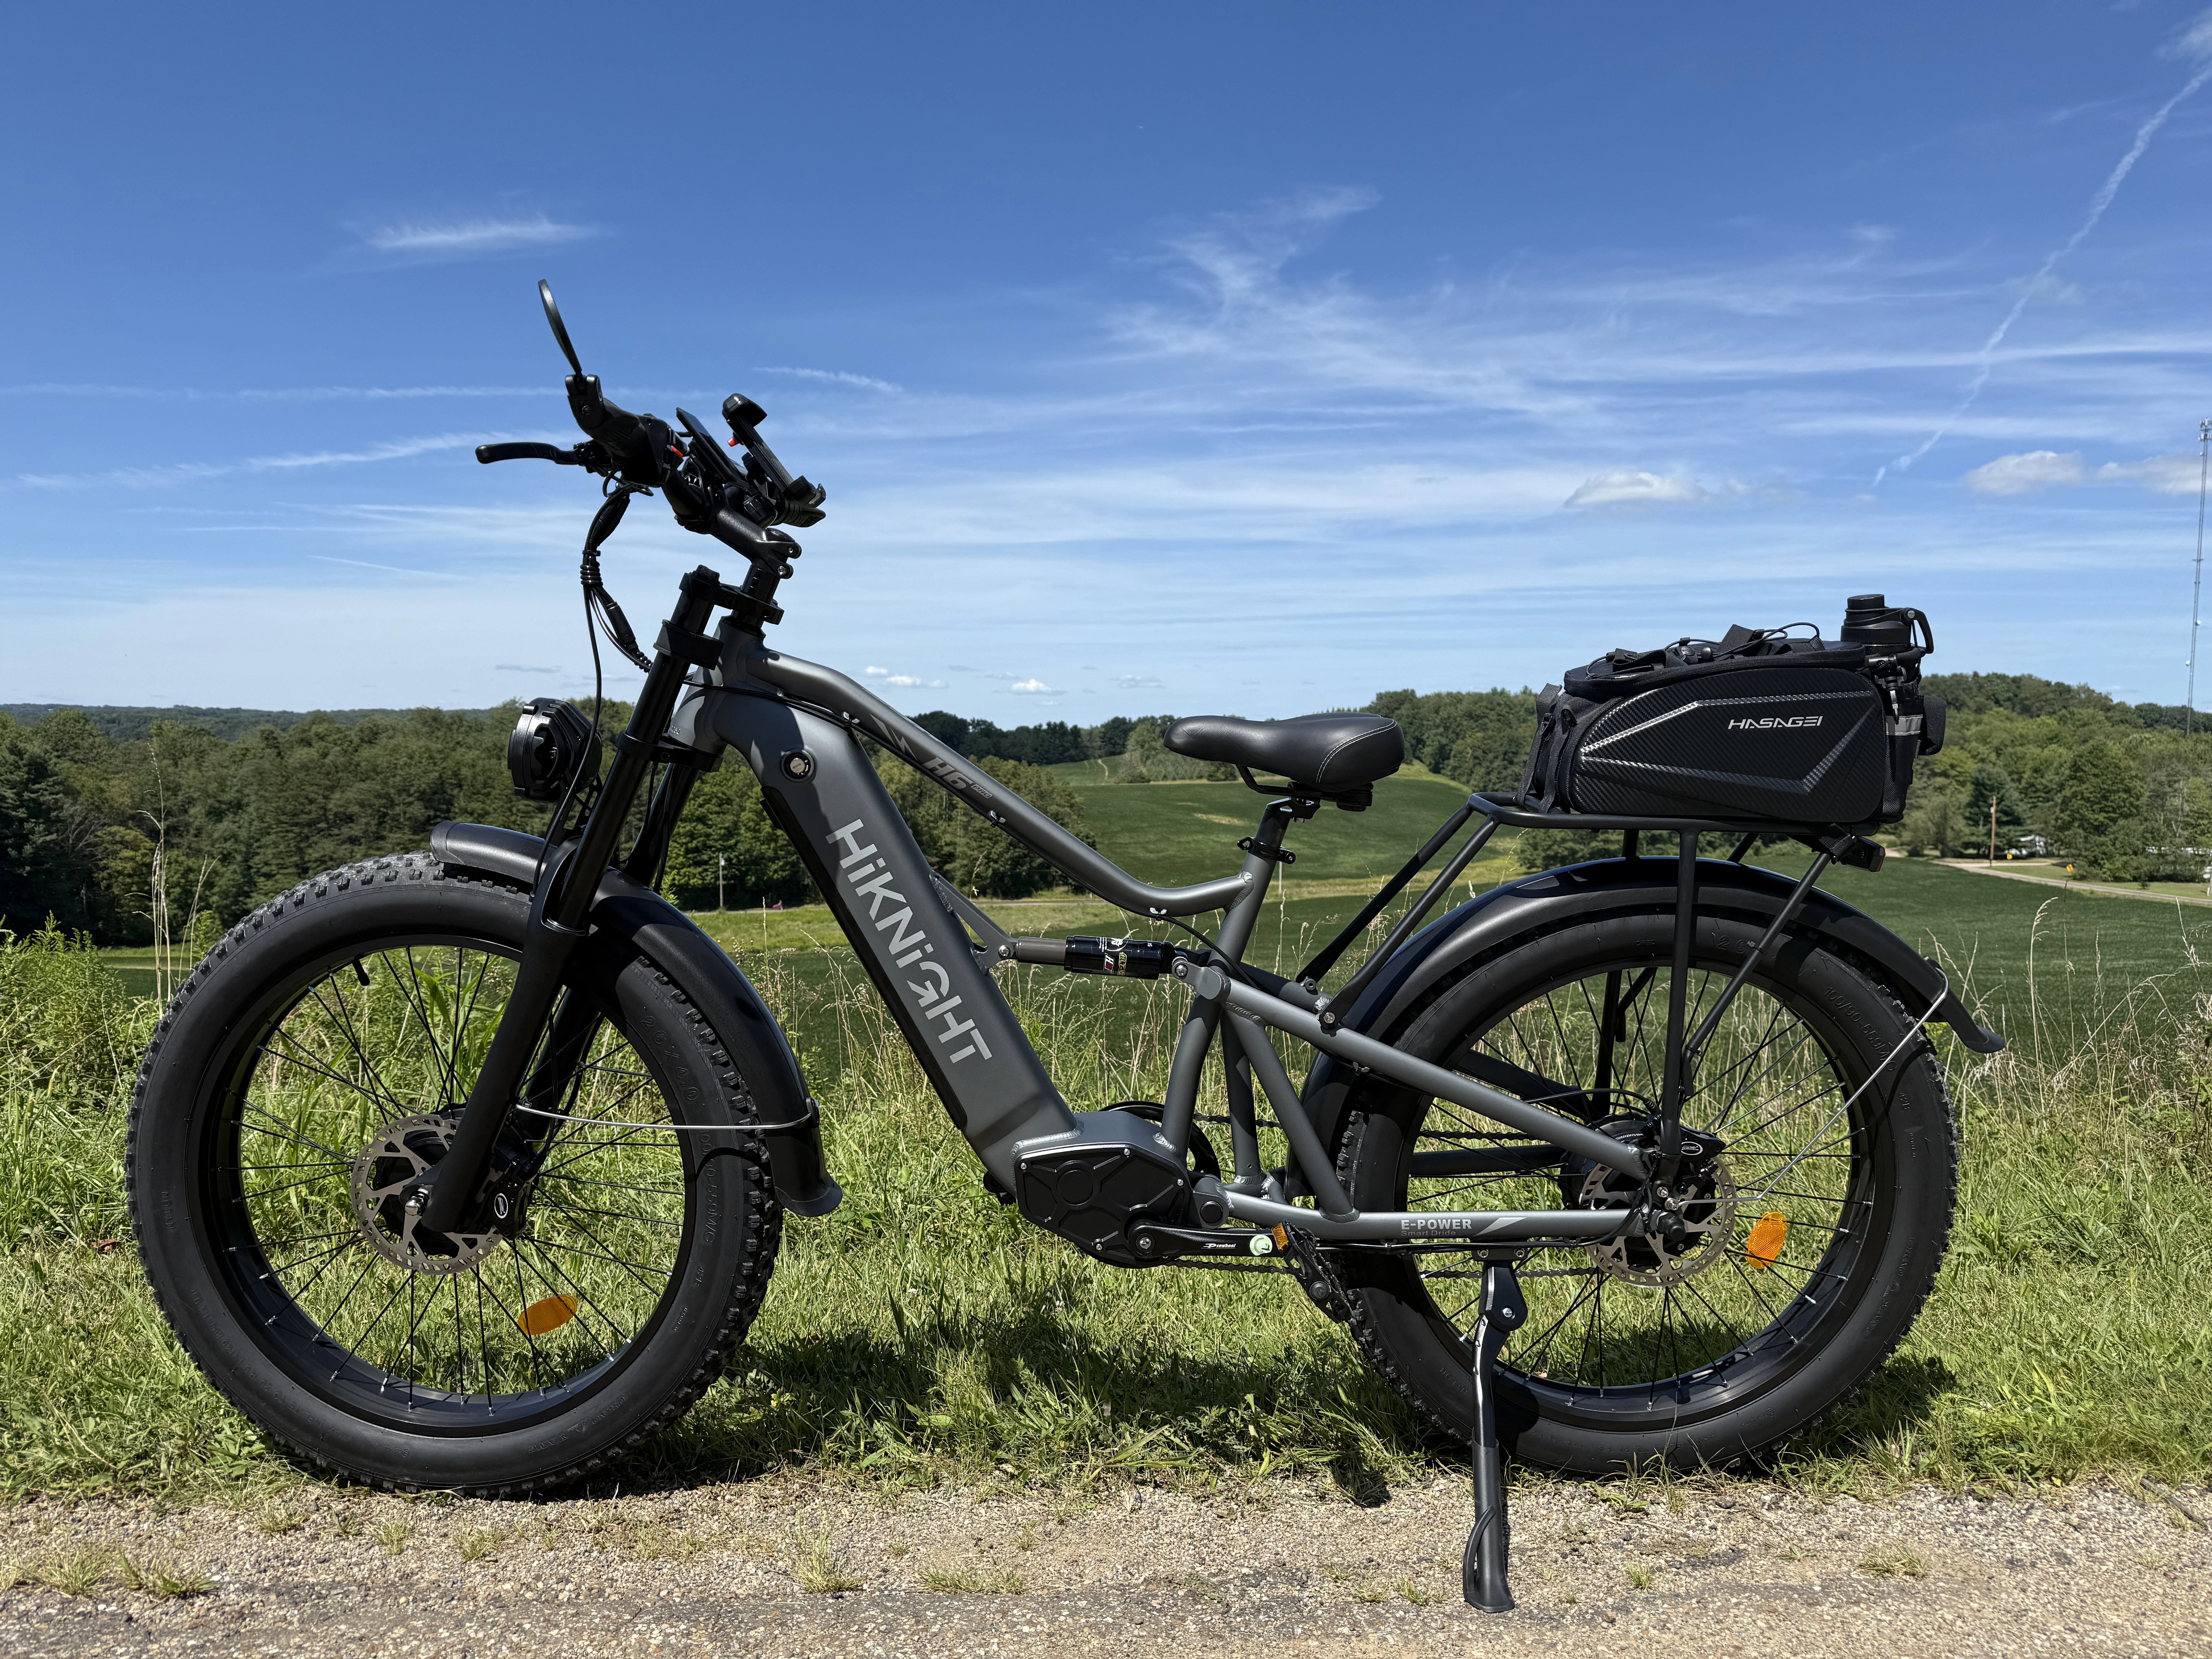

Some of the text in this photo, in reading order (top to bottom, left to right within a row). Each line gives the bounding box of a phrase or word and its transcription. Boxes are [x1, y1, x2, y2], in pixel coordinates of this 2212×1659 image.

[1728, 716, 1823, 729] HASAGEI
[922, 757, 992, 798] H6 PRO
[162, 1191, 174, 1230] NYLON
[1401, 1219, 1472, 1230] E-POWER
[1438, 1367, 1468, 1395] NYLON
